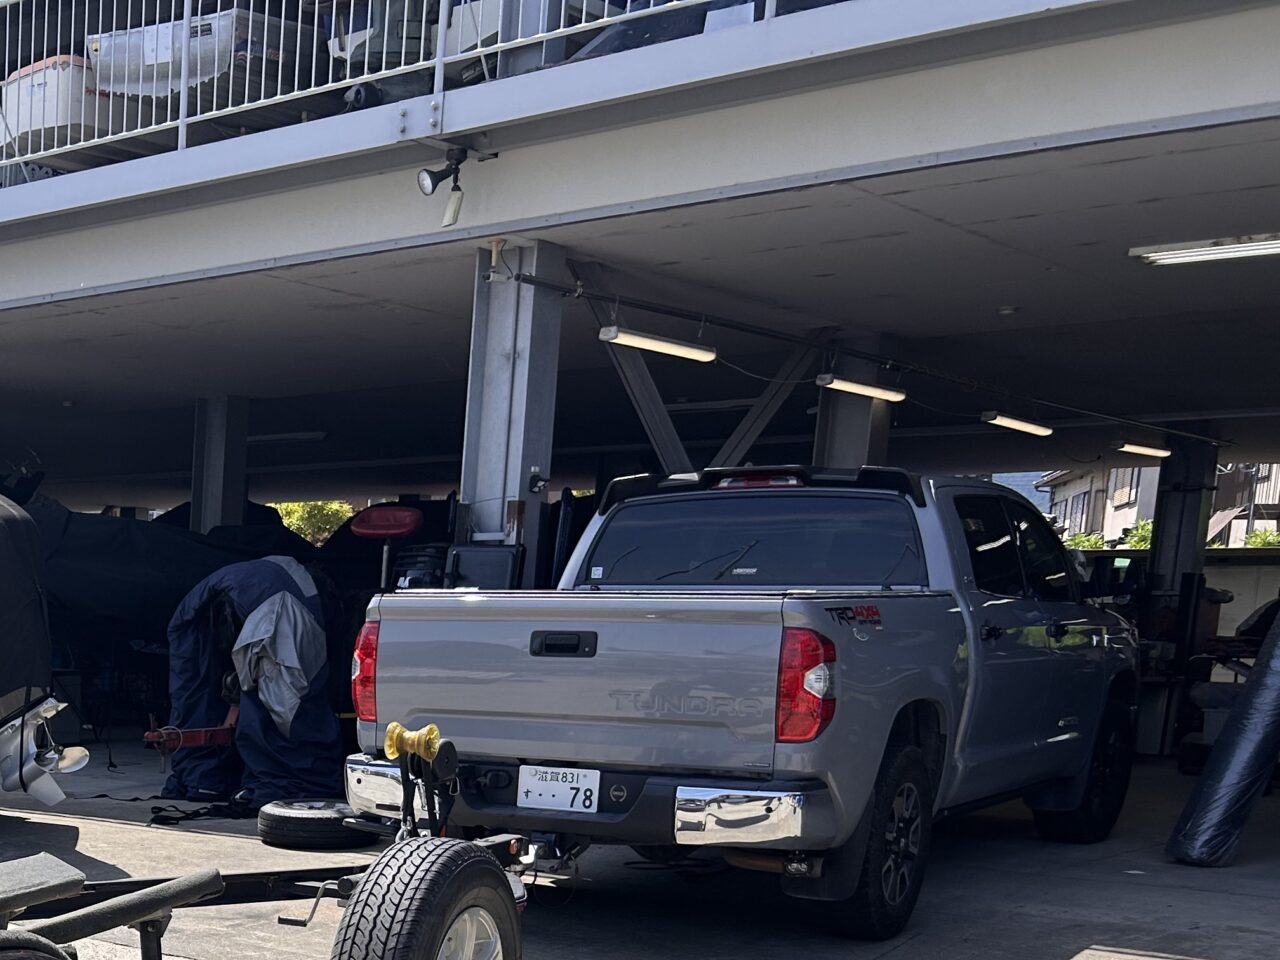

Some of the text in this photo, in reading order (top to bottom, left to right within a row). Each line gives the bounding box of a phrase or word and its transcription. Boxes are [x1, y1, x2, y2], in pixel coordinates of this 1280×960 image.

[824, 607, 856, 626] TRD
[609, 690, 763, 717] TUNDRA
[569, 787, 593, 809] 78
